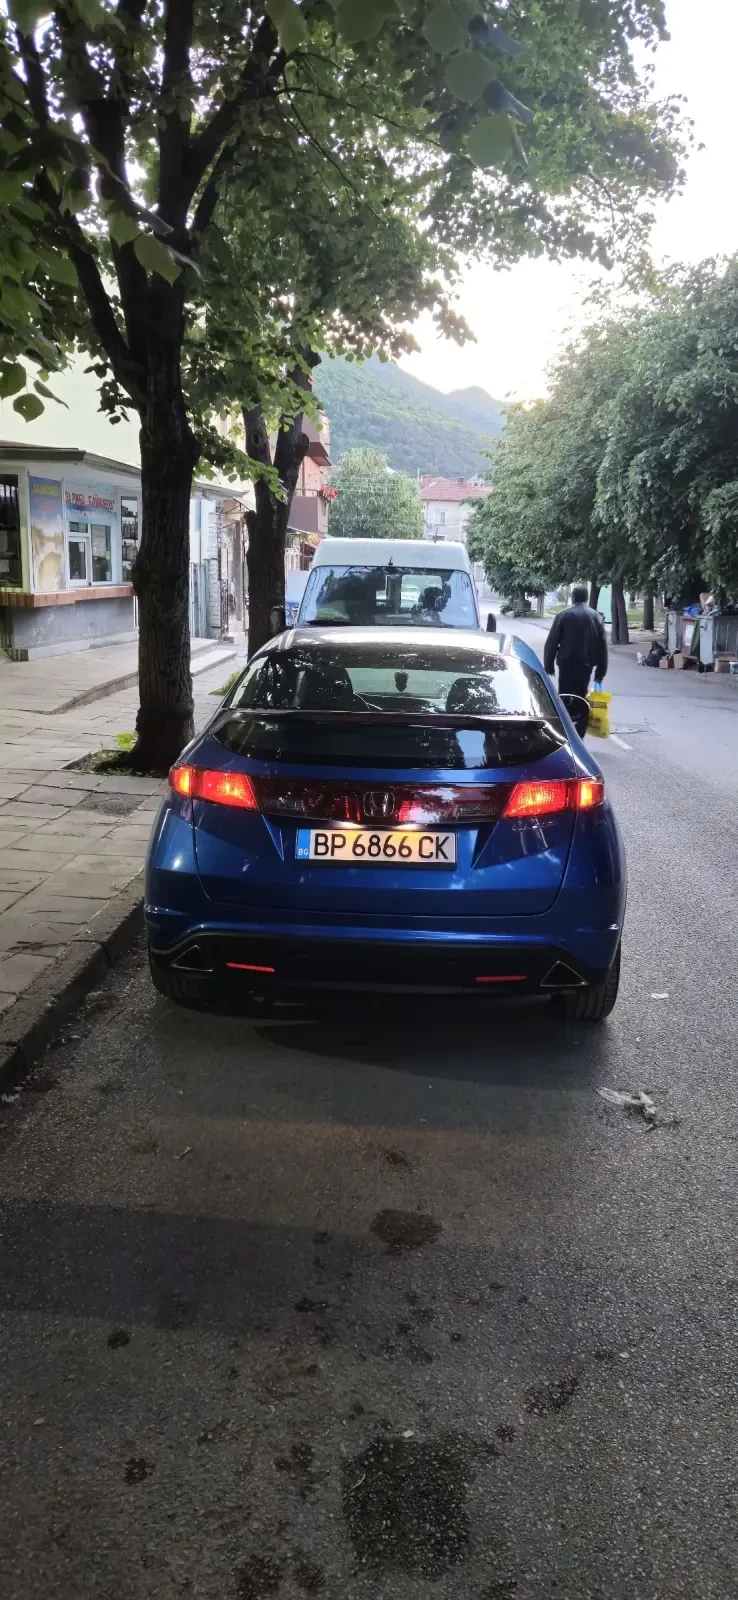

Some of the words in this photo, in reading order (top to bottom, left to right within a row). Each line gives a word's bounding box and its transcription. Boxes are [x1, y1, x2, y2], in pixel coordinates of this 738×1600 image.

[314, 833, 347, 857] BP
[352, 834, 412, 858] 6866
[418, 836, 450, 860] CK
